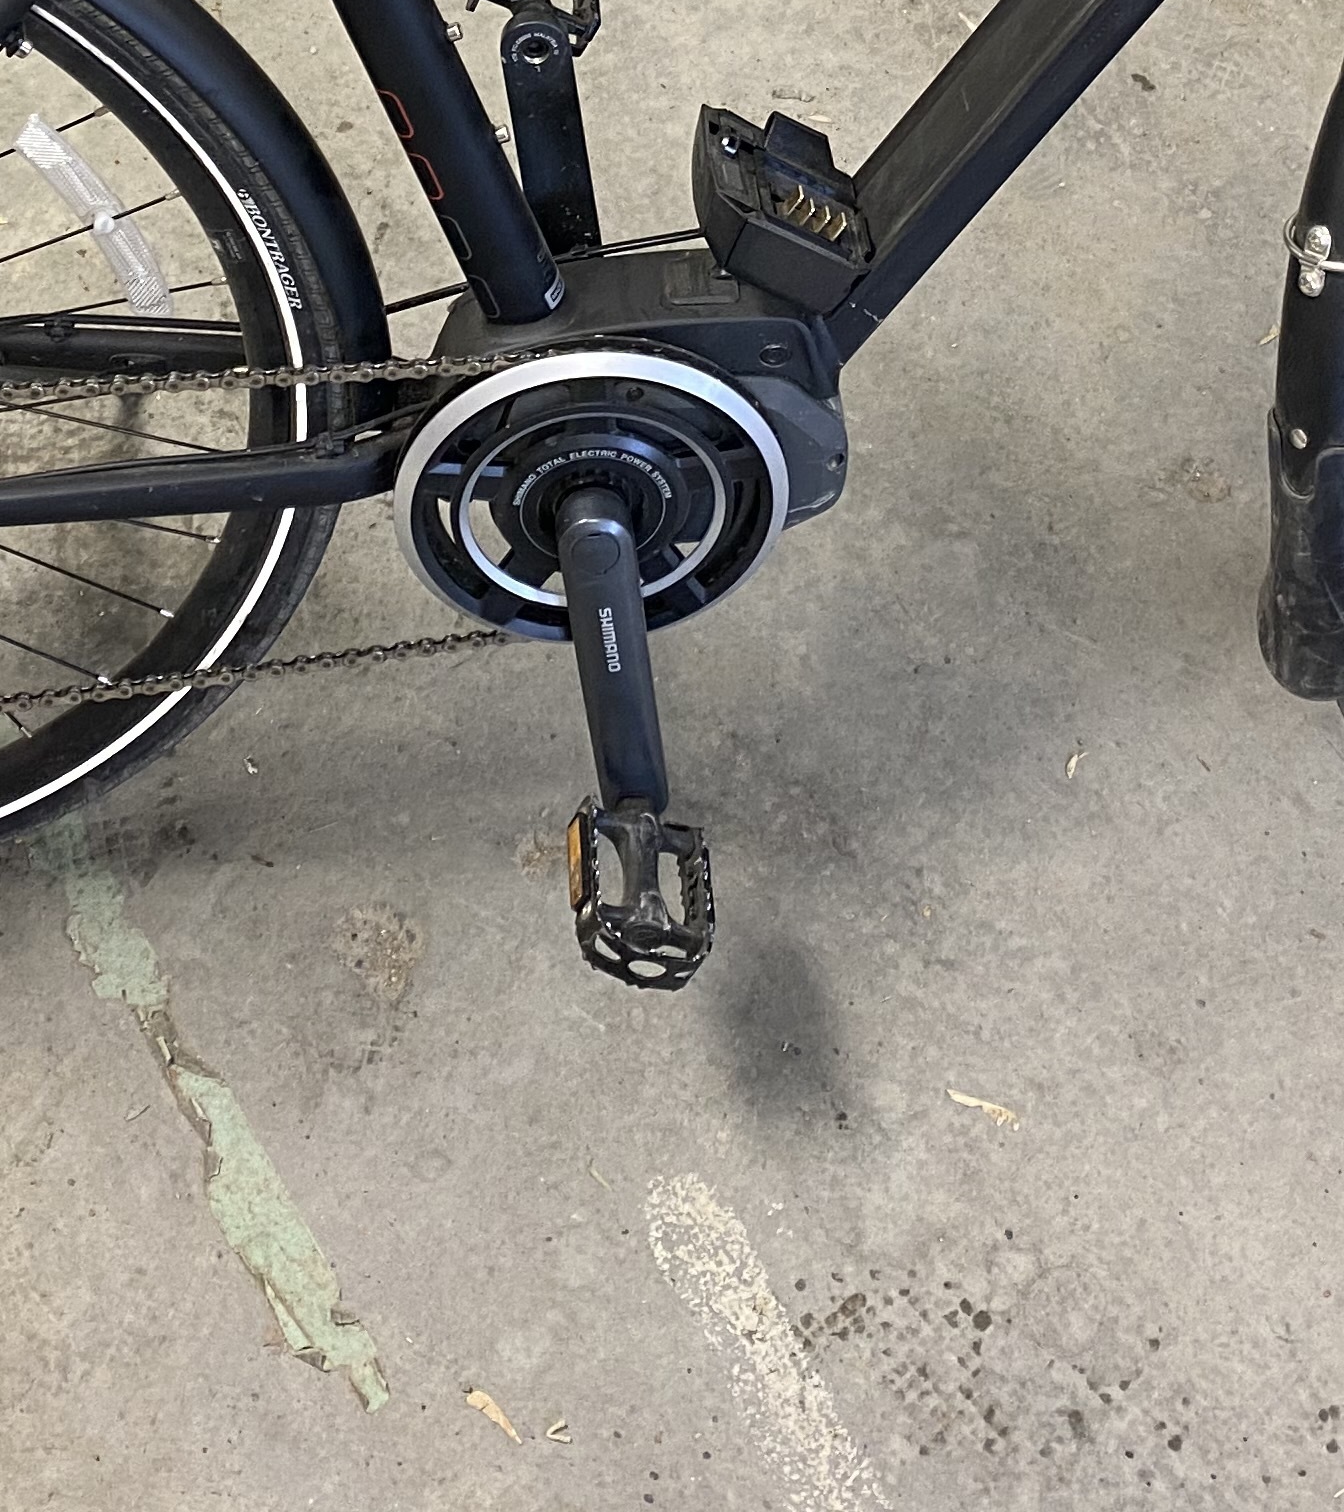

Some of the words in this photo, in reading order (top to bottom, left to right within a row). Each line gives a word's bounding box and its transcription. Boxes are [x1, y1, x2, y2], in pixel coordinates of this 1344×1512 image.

[244, 201, 303, 310] BONTRAGER
[536, 455, 568, 474] TOTAL
[569, 449, 618, 461] ELECTRIC
[620, 452, 653, 473] POWER
[651, 470, 673, 500] SYSTEM
[599, 607, 622, 674] SHIMANO
